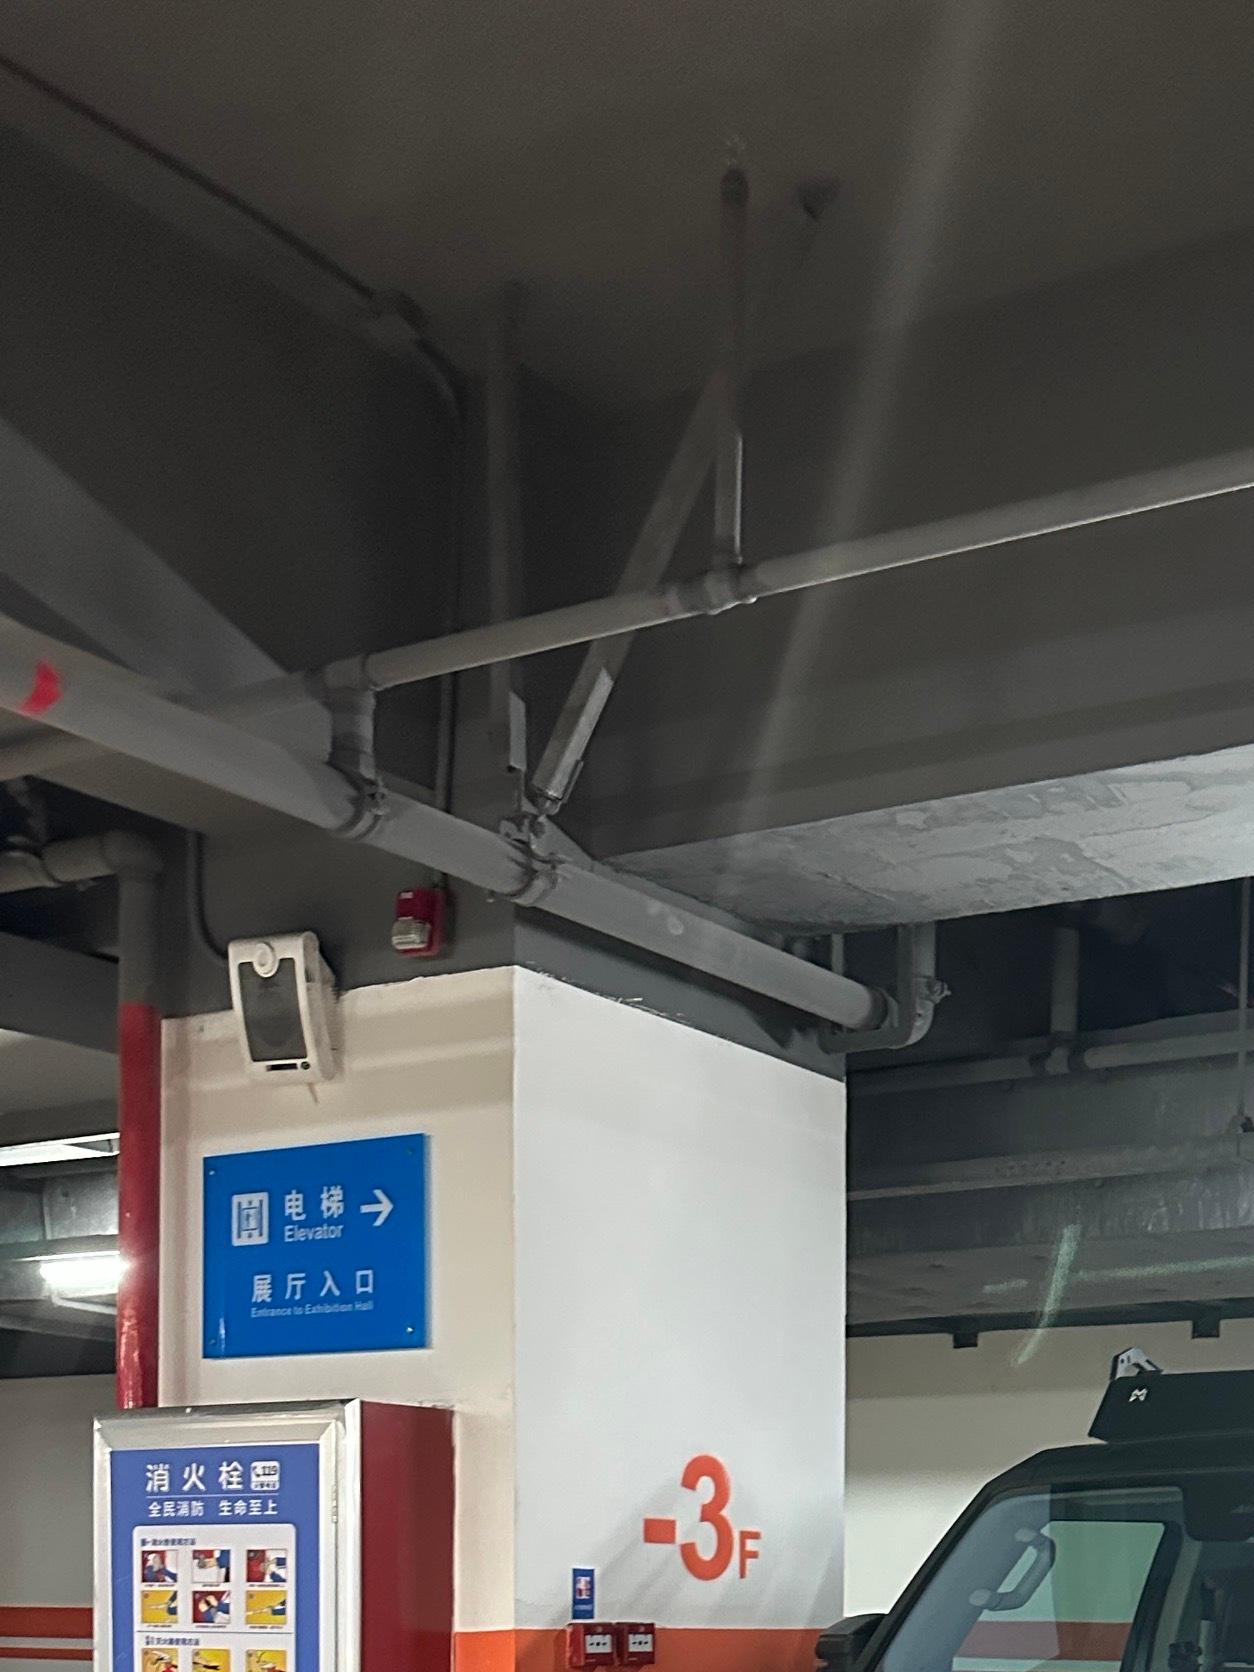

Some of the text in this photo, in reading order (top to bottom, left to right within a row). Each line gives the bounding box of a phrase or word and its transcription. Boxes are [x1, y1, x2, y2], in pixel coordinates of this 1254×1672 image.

[284, 1185, 344, 1222] 电梯
[284, 1223, 344, 1243] Elevator
[252, 1269, 374, 1304] 展厅入口
[250, 1307, 292, 1319] Entrance
[145, 1461, 245, 1493] 消火栓
[148, 1499, 279, 1518] 全民消防 生命至上
